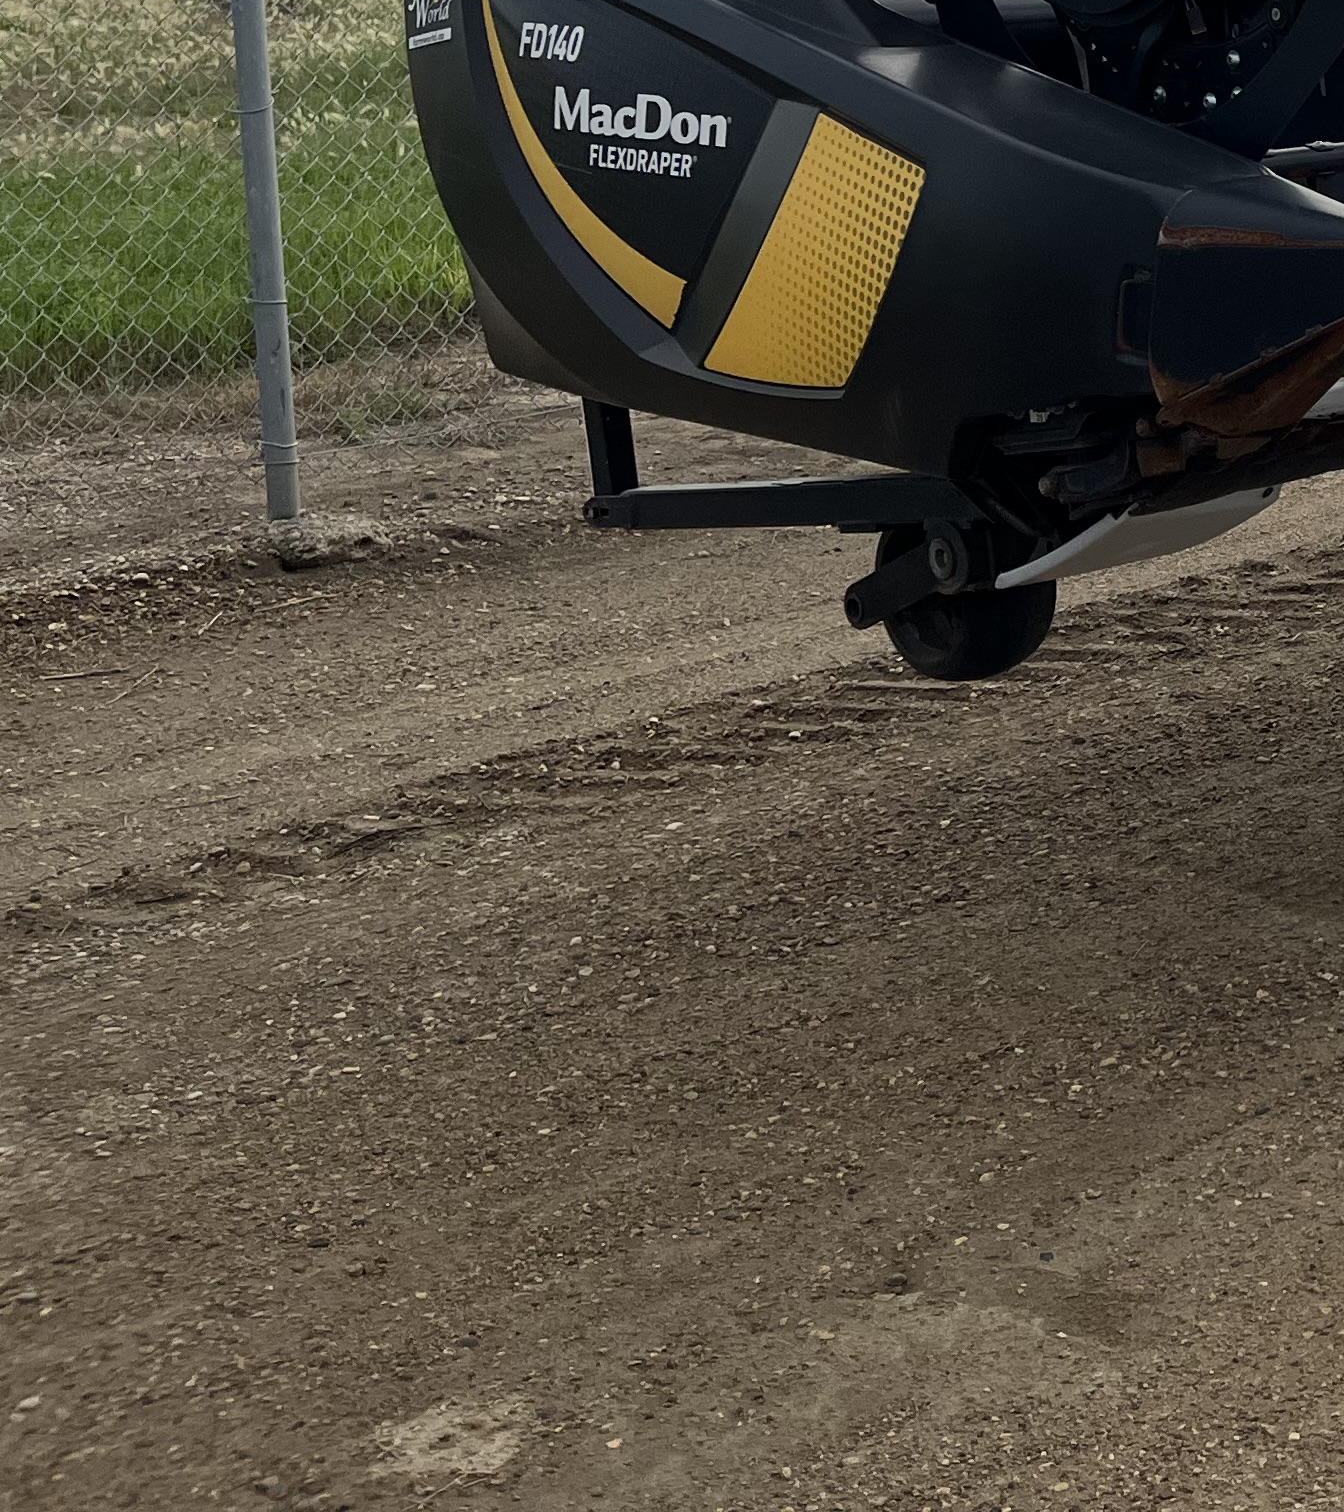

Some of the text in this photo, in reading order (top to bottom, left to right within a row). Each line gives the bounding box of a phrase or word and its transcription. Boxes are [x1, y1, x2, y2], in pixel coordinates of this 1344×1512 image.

[519, 22, 585, 62] FD140
[553, 86, 728, 148] MacDon
[589, 144, 692, 178] FLEXDRAPER
